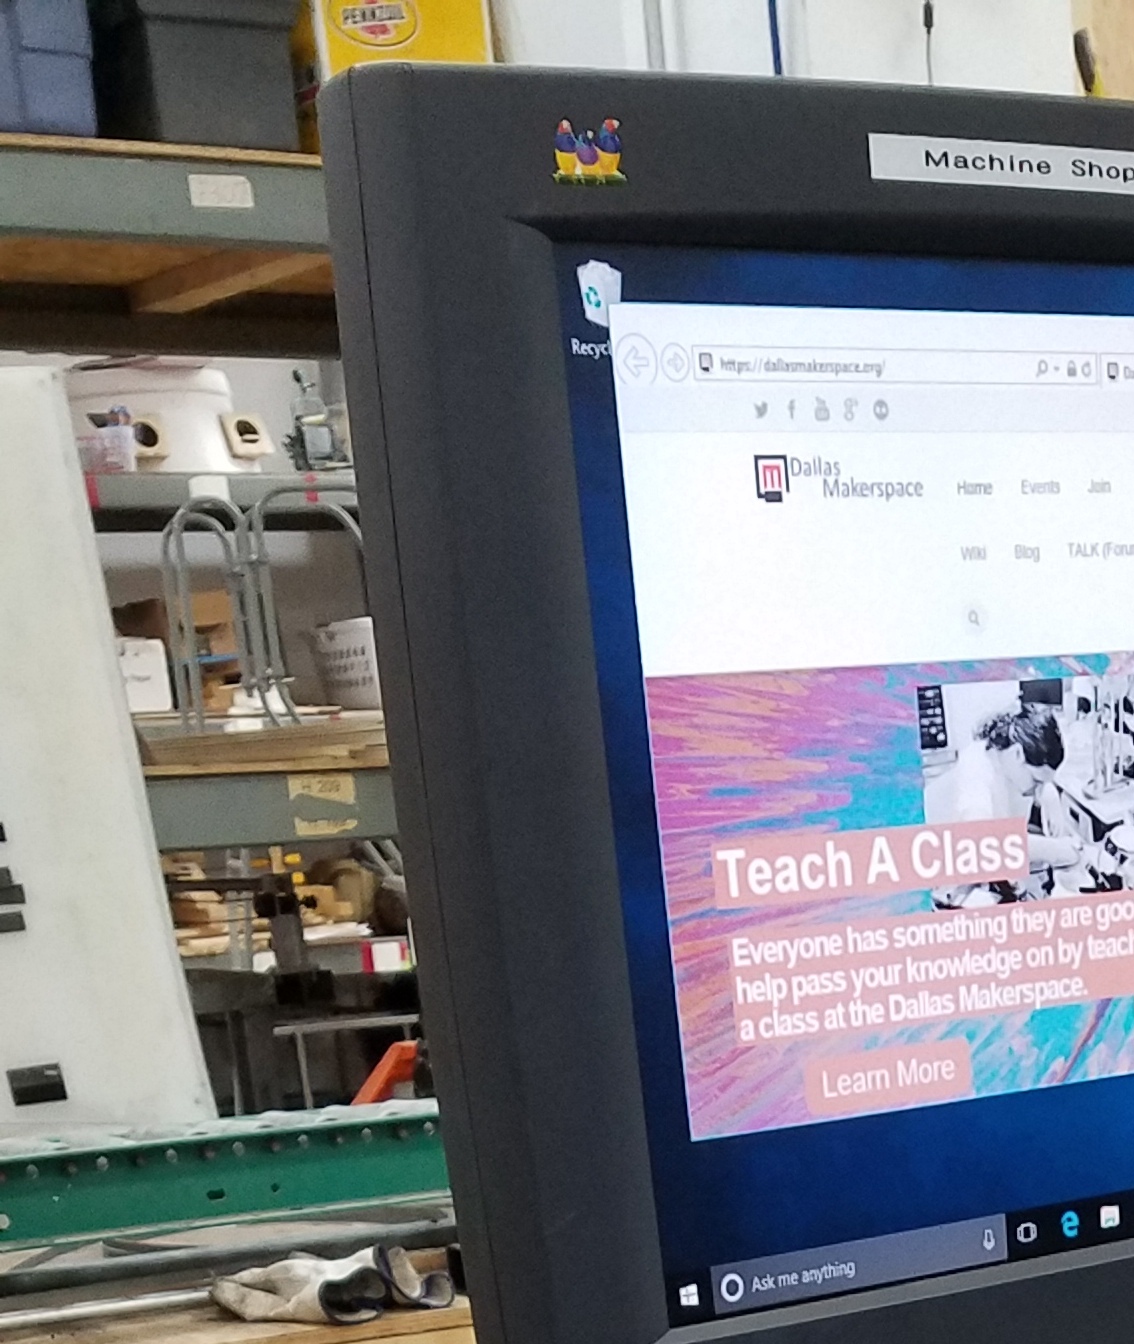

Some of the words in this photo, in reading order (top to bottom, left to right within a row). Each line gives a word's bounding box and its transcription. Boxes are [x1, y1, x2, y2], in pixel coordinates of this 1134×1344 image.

[924, 149, 1052, 176] Machine
[790, 456, 841, 477] Dallas
[822, 477, 924, 502] Makerspace
[956, 480, 994, 496] Home
[1020, 478, 1062, 495] Events
[960, 544, 988, 562] Wiki
[1013, 543, 1041, 563] Blog
[1066, 541, 1100, 559] TALK
[715, 840, 853, 899] Teach
[866, 835, 901, 885] A
[910, 829, 1027, 880] Class
[731, 932, 845, 970] Everyone
[845, 925, 890, 954] has
[891, 910, 1008, 949] something
[1010, 905, 1056, 939] they
[1060, 904, 1093, 929] are
[735, 972, 788, 1008] help
[791, 969, 848, 1006] pass
[849, 963, 903, 998] your
[905, 945, 1023, 984] knowledge
[1025, 948, 1055, 967] on
[1057, 937, 1084, 970] by
[739, 1017, 756, 1042] a
[758, 1008, 820, 1039] class
[823, 1001, 847, 1031] at
[847, 999, 886, 1028] the
[888, 989, 956, 1023] Dallas
[958, 976, 1089, 1013] Makerspace.
[821, 1068, 891, 1099] Learn
[895, 1057, 957, 1088] More
[751, 1275, 776, 1293] Ask
[778, 1272, 799, 1288] me
[801, 1260, 857, 1285] anything
